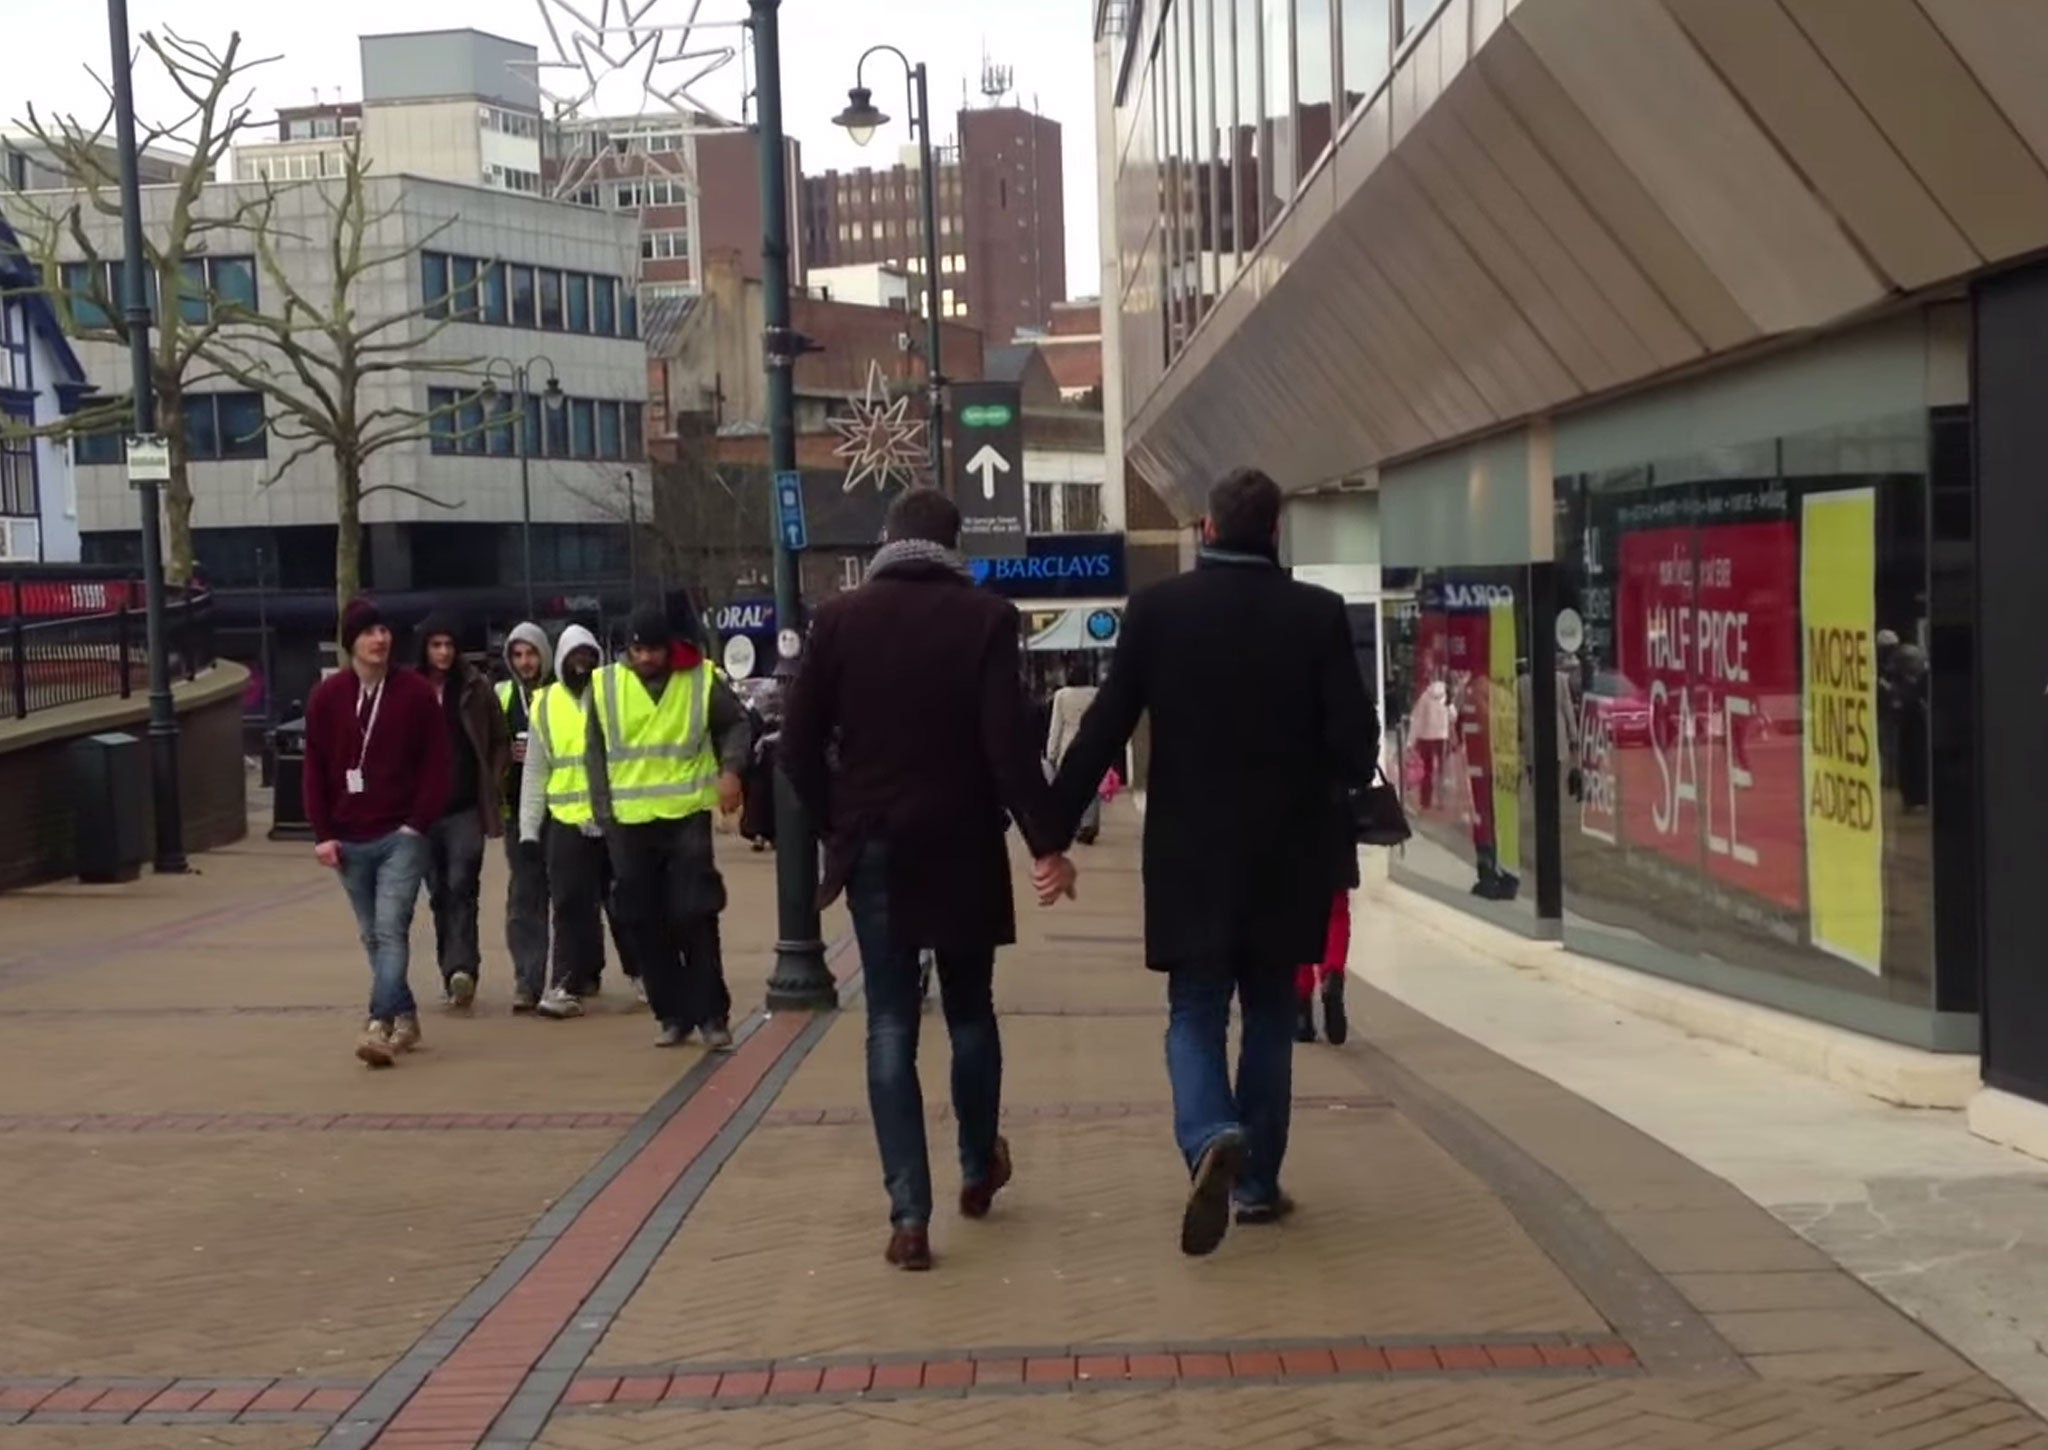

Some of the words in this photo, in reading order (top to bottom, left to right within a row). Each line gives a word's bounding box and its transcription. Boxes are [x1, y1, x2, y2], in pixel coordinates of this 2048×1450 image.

[996, 555, 1110, 578] BARCLAYS
[1646, 604, 1691, 671] HALF
[1698, 609, 1749, 682] PRICE
[1810, 627, 1868, 692] MORE
[1811, 691, 1869, 767] LINES
[1650, 680, 1759, 866] SALE
[1810, 770, 1874, 832] ADDED
